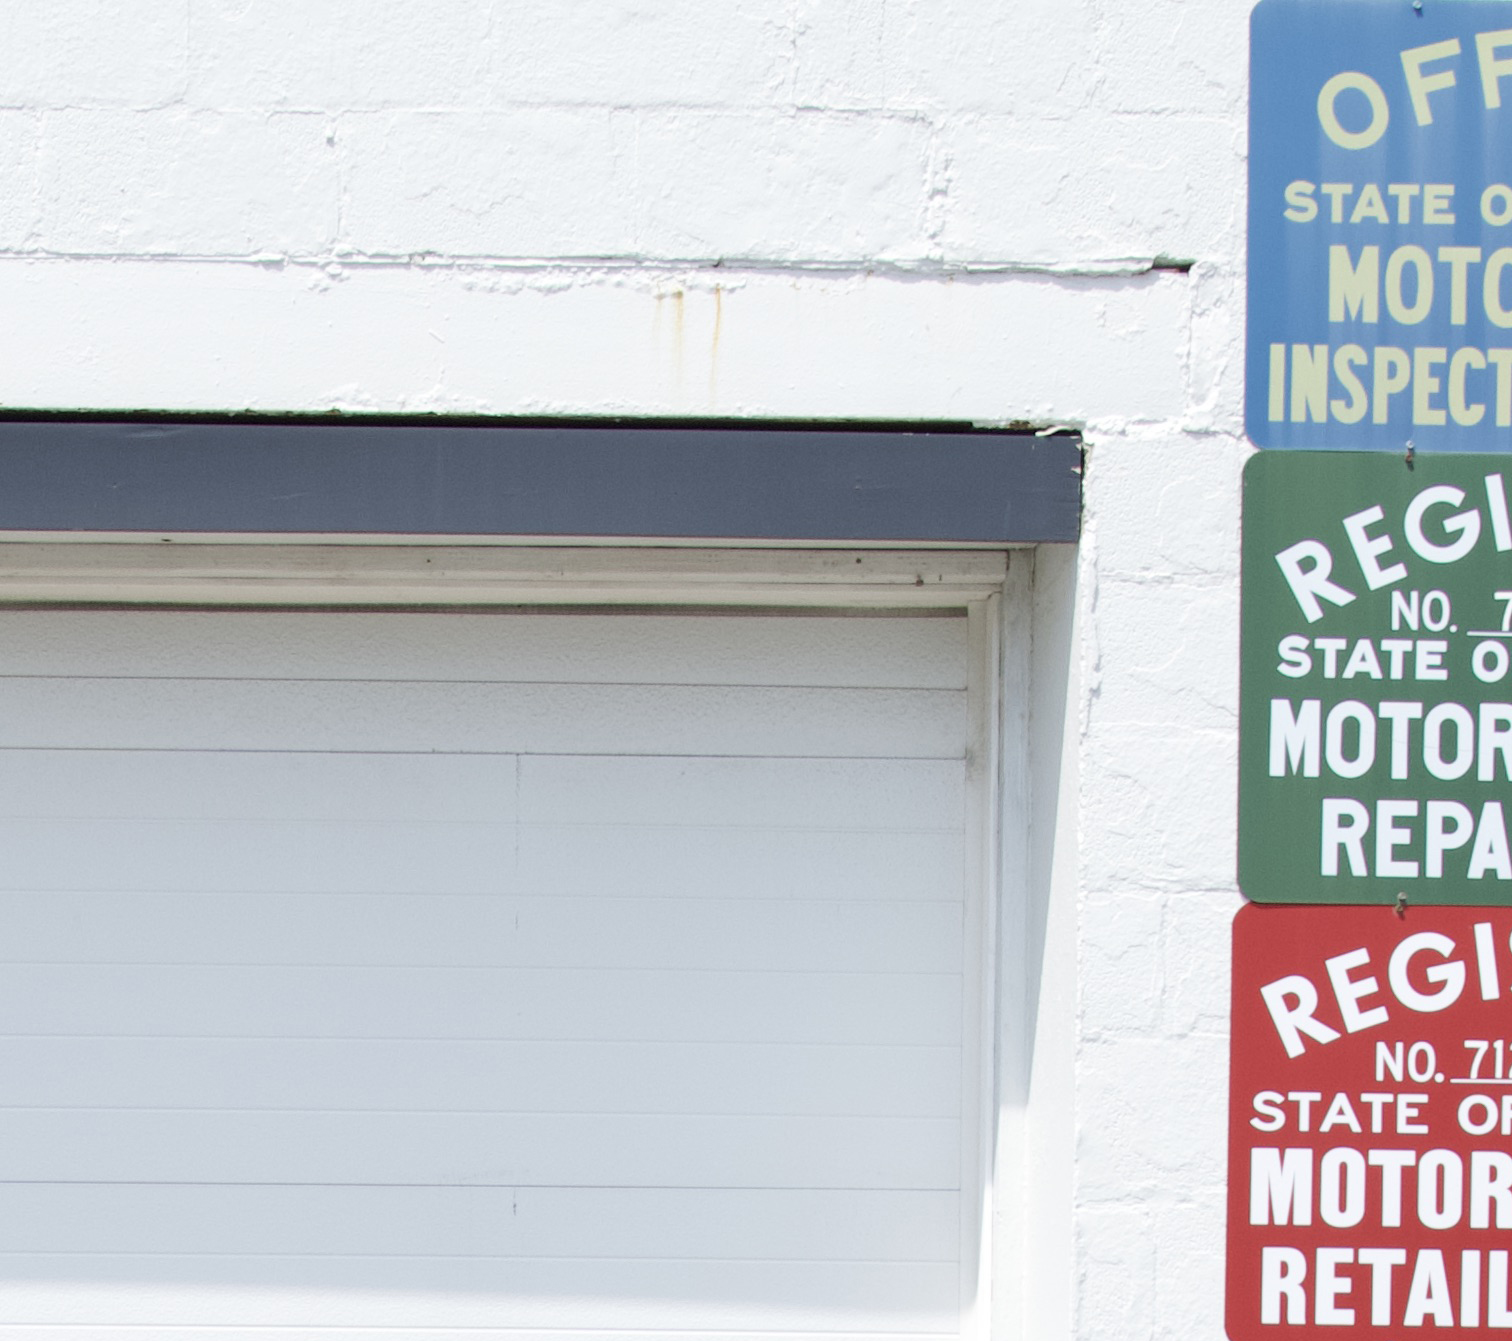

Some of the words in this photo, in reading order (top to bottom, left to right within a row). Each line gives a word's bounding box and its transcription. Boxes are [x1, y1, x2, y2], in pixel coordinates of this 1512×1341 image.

[1283, 181, 1455, 224] STATE
[1391, 591, 1457, 633] NO.
[1277, 637, 1448, 681] STATE
[1376, 1041, 1444, 1083] NO.
[1250, 1091, 1429, 1134] STATE
